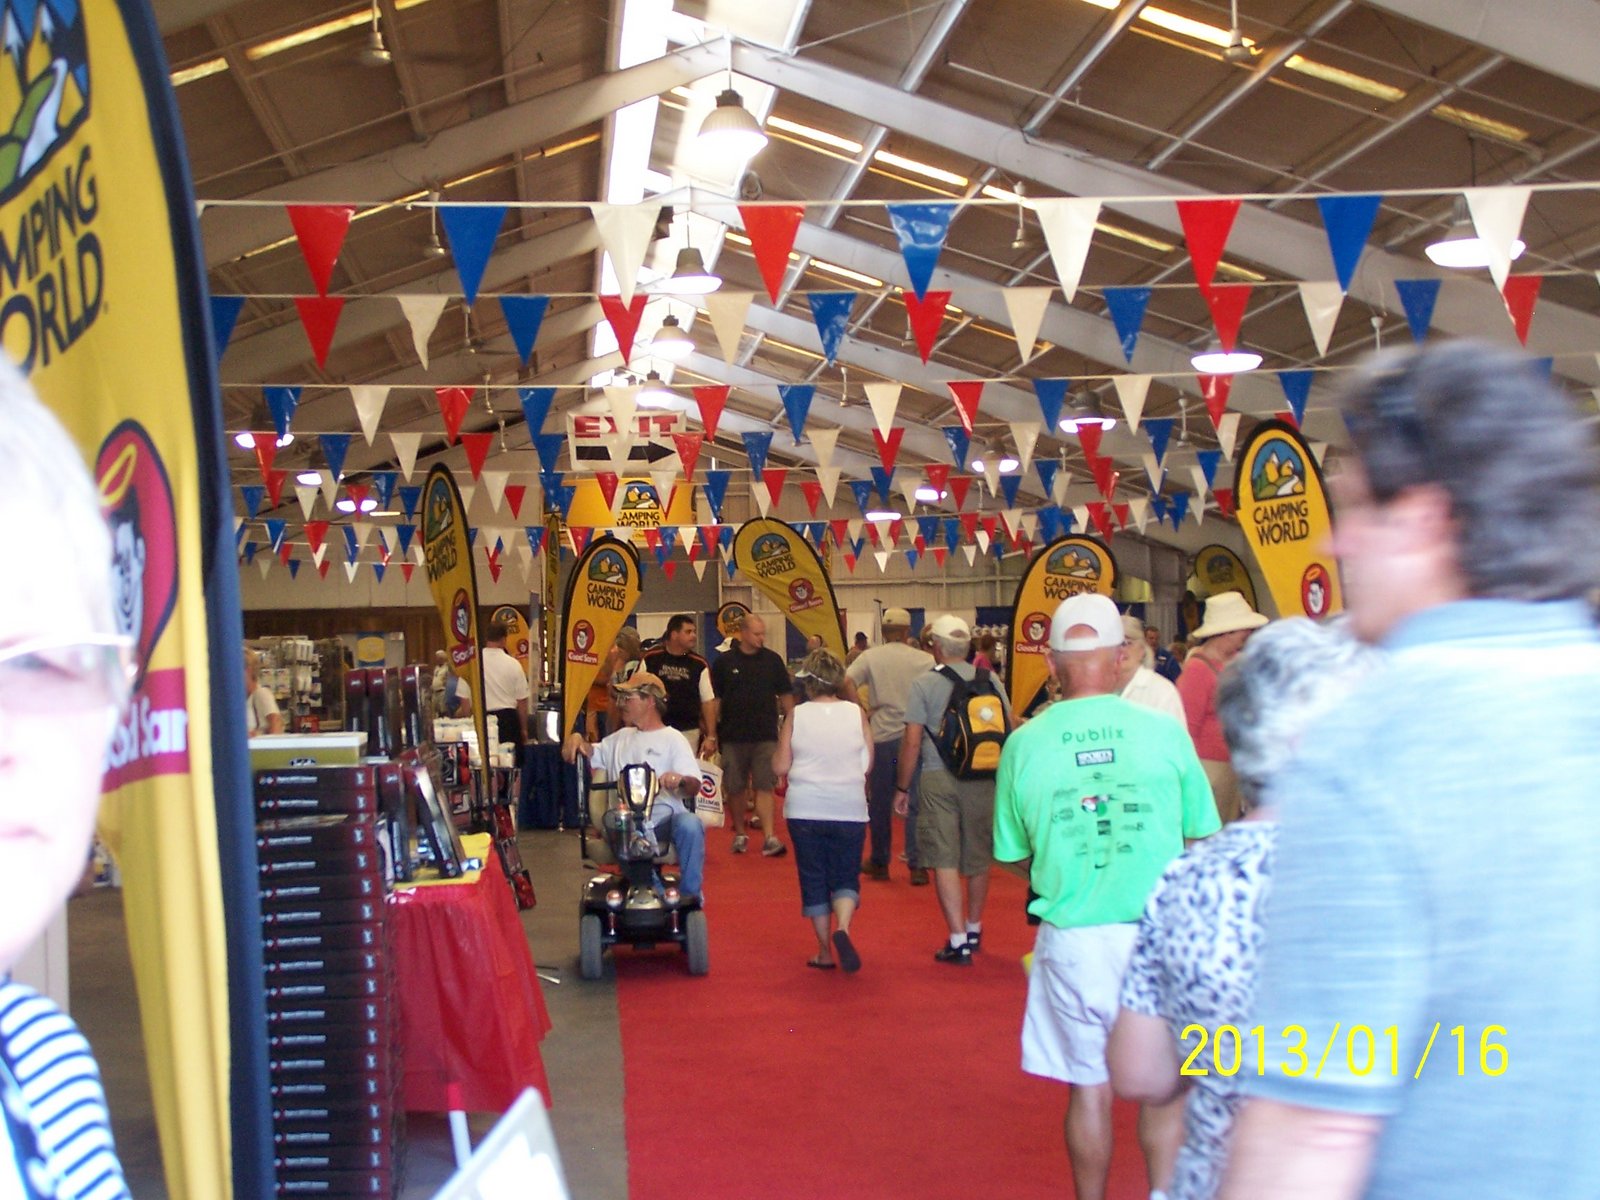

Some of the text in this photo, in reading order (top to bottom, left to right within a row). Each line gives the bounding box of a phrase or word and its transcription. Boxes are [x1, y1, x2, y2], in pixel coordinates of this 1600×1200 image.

[0, 144, 98, 290] MPING
[0, 232, 104, 377] ORLD
[618, 511, 660, 521] AMPING
[1253, 499, 1308, 525] CAMPING
[1255, 519, 1310, 546] WORLD
[755, 553, 794, 570] CAMPING
[757, 561, 796, 577] WORLD
[586, 583, 626, 599] CAMPING
[1044, 576, 1097, 593] CAMPING
[586, 593, 625, 611] WORLD
